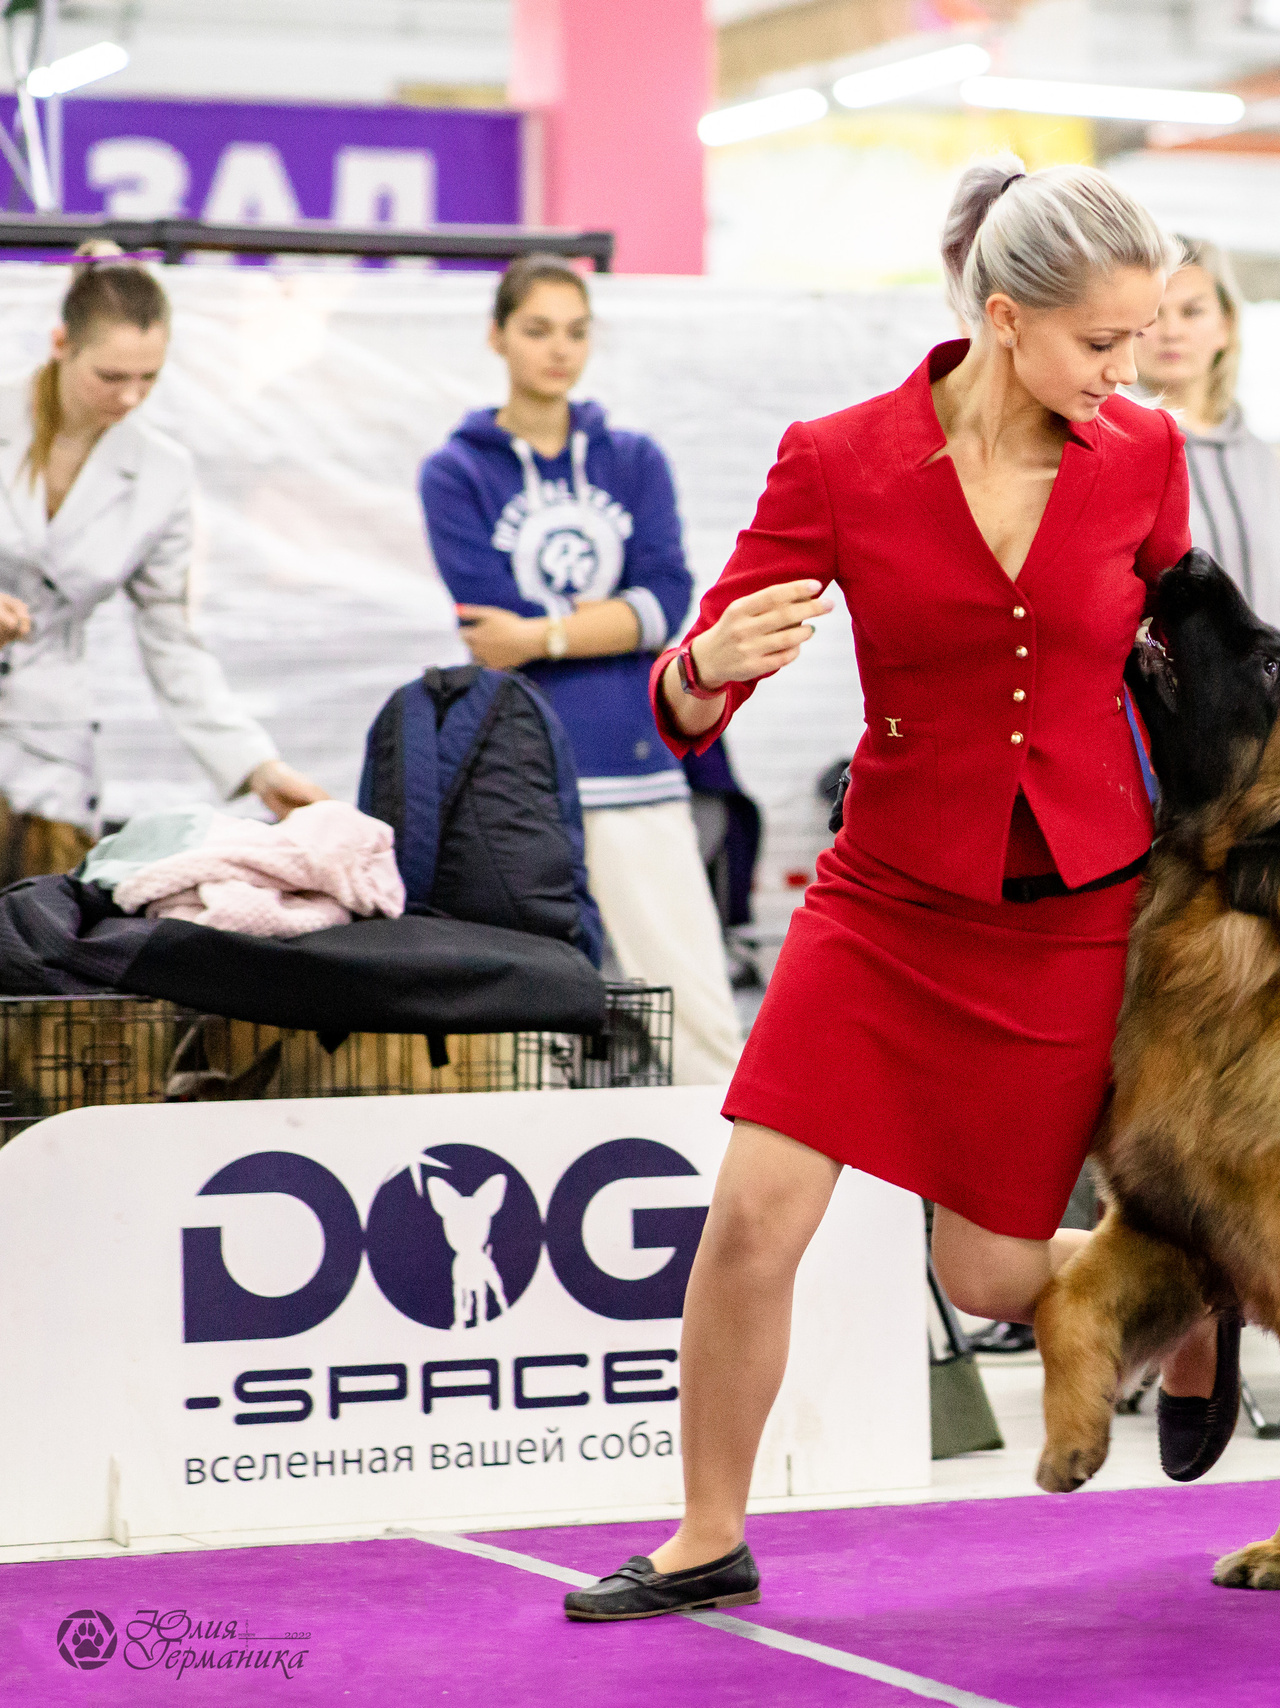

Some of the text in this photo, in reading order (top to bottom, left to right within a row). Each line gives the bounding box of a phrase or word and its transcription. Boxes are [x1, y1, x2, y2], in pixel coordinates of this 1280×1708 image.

[182, 1137, 710, 1343] DOG
[185, 1348, 679, 1425] -SPACE
[185, 1420, 674, 1485] вселенная вашей соба
